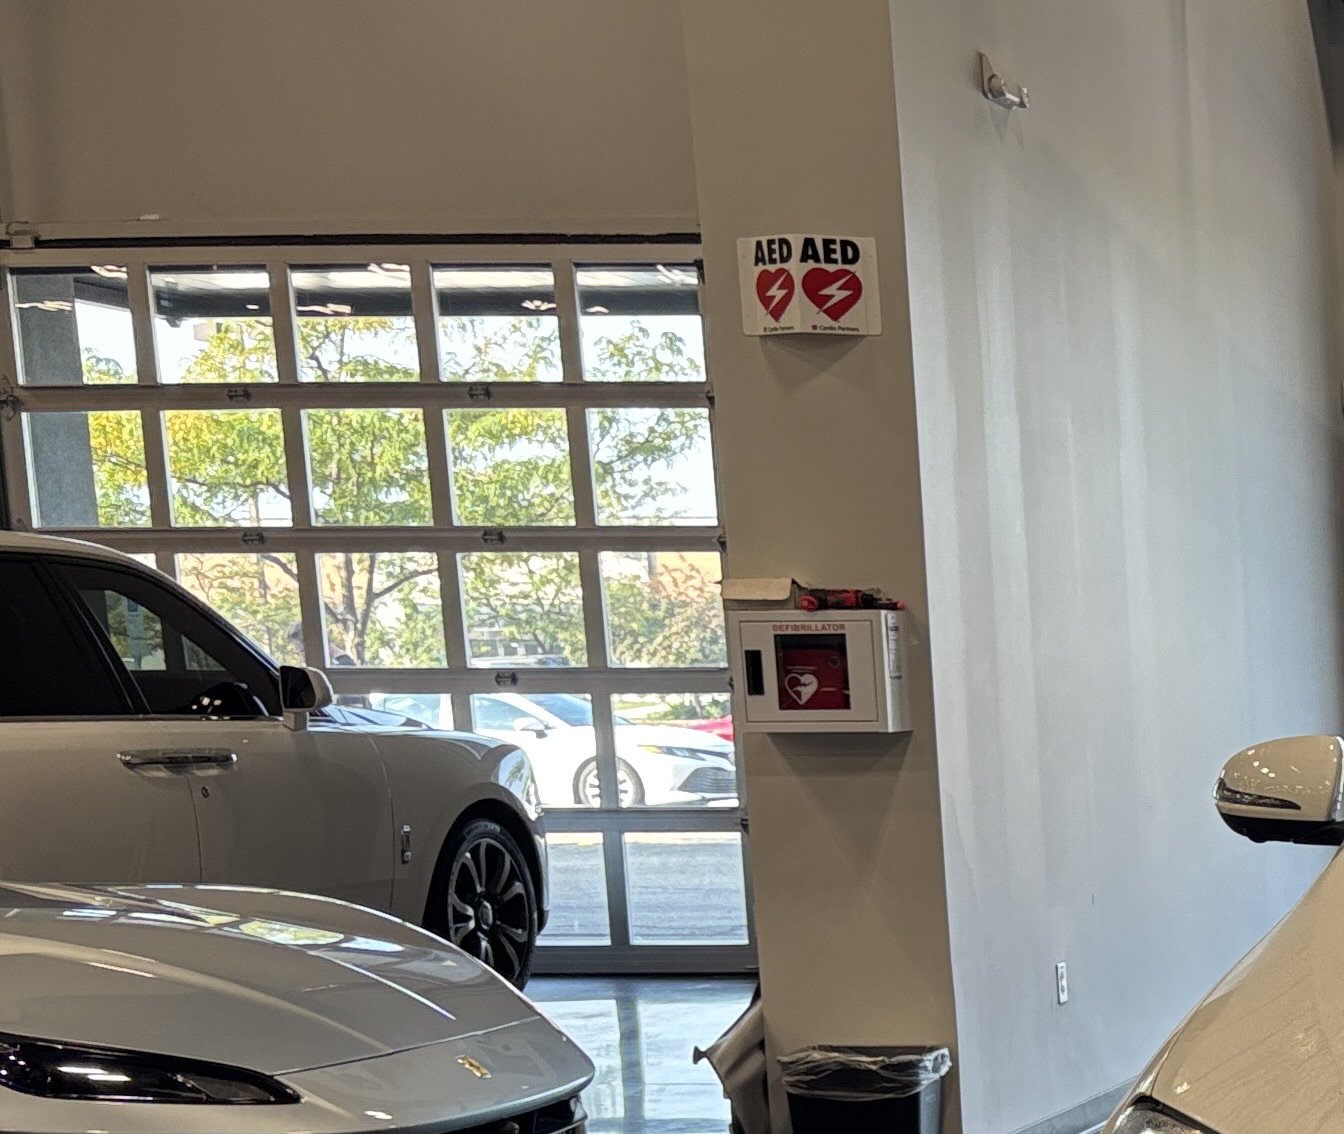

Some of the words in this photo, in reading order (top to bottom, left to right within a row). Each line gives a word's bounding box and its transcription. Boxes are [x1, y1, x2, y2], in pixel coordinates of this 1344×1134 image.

[754, 237, 792, 266] AED
[800, 237, 860, 265] AED
[772, 623, 846, 632] DEFIBRILLATOR
